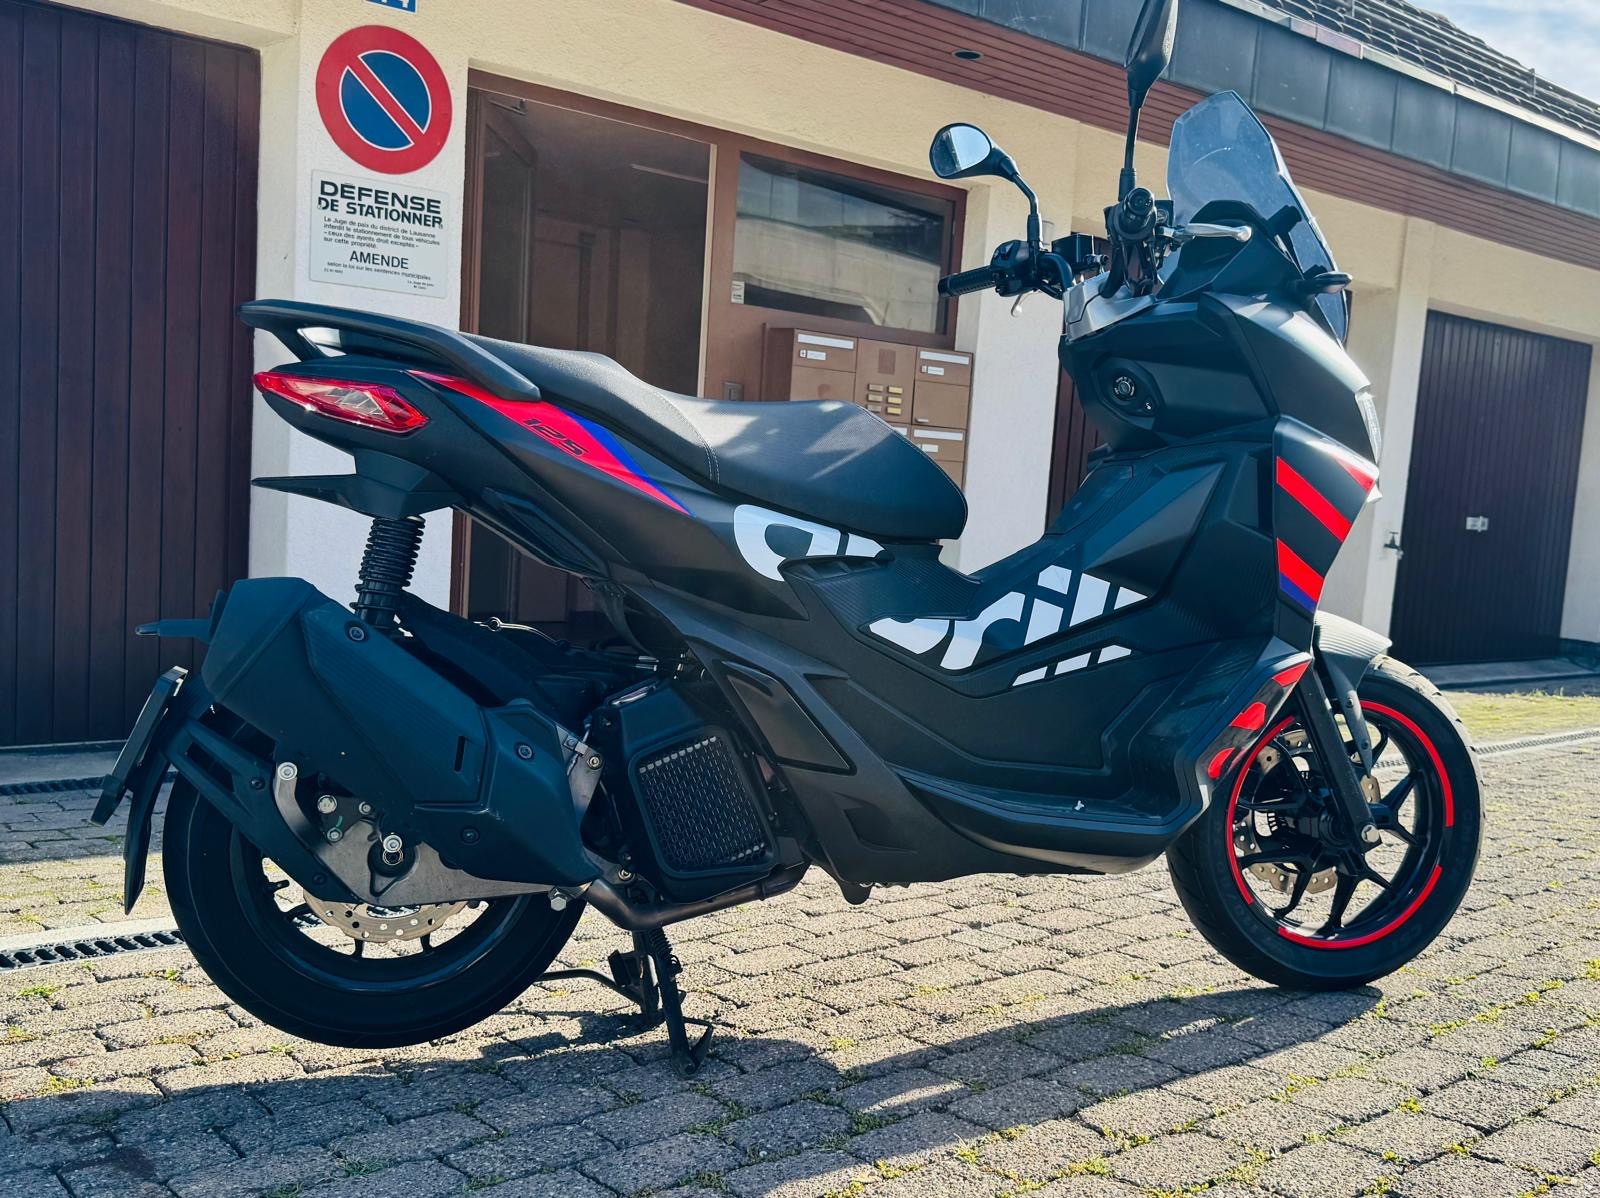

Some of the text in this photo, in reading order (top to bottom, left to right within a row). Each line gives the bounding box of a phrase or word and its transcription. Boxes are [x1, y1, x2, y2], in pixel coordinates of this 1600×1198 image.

[318, 197, 443, 229] DE STATIONNER
[323, 223, 345, 232] interdit
[353, 227, 392, 239] stationnement
[402, 234, 414, 242] tous
[333, 217, 347, 226] Juge
[357, 221, 369, 229] paix
[379, 224, 400, 233] district
[409, 229, 436, 239] Lausanne
[376, 236, 389, 244] droit
[349, 250, 409, 269] AMENDE
[523, 418, 589, 456] 125
